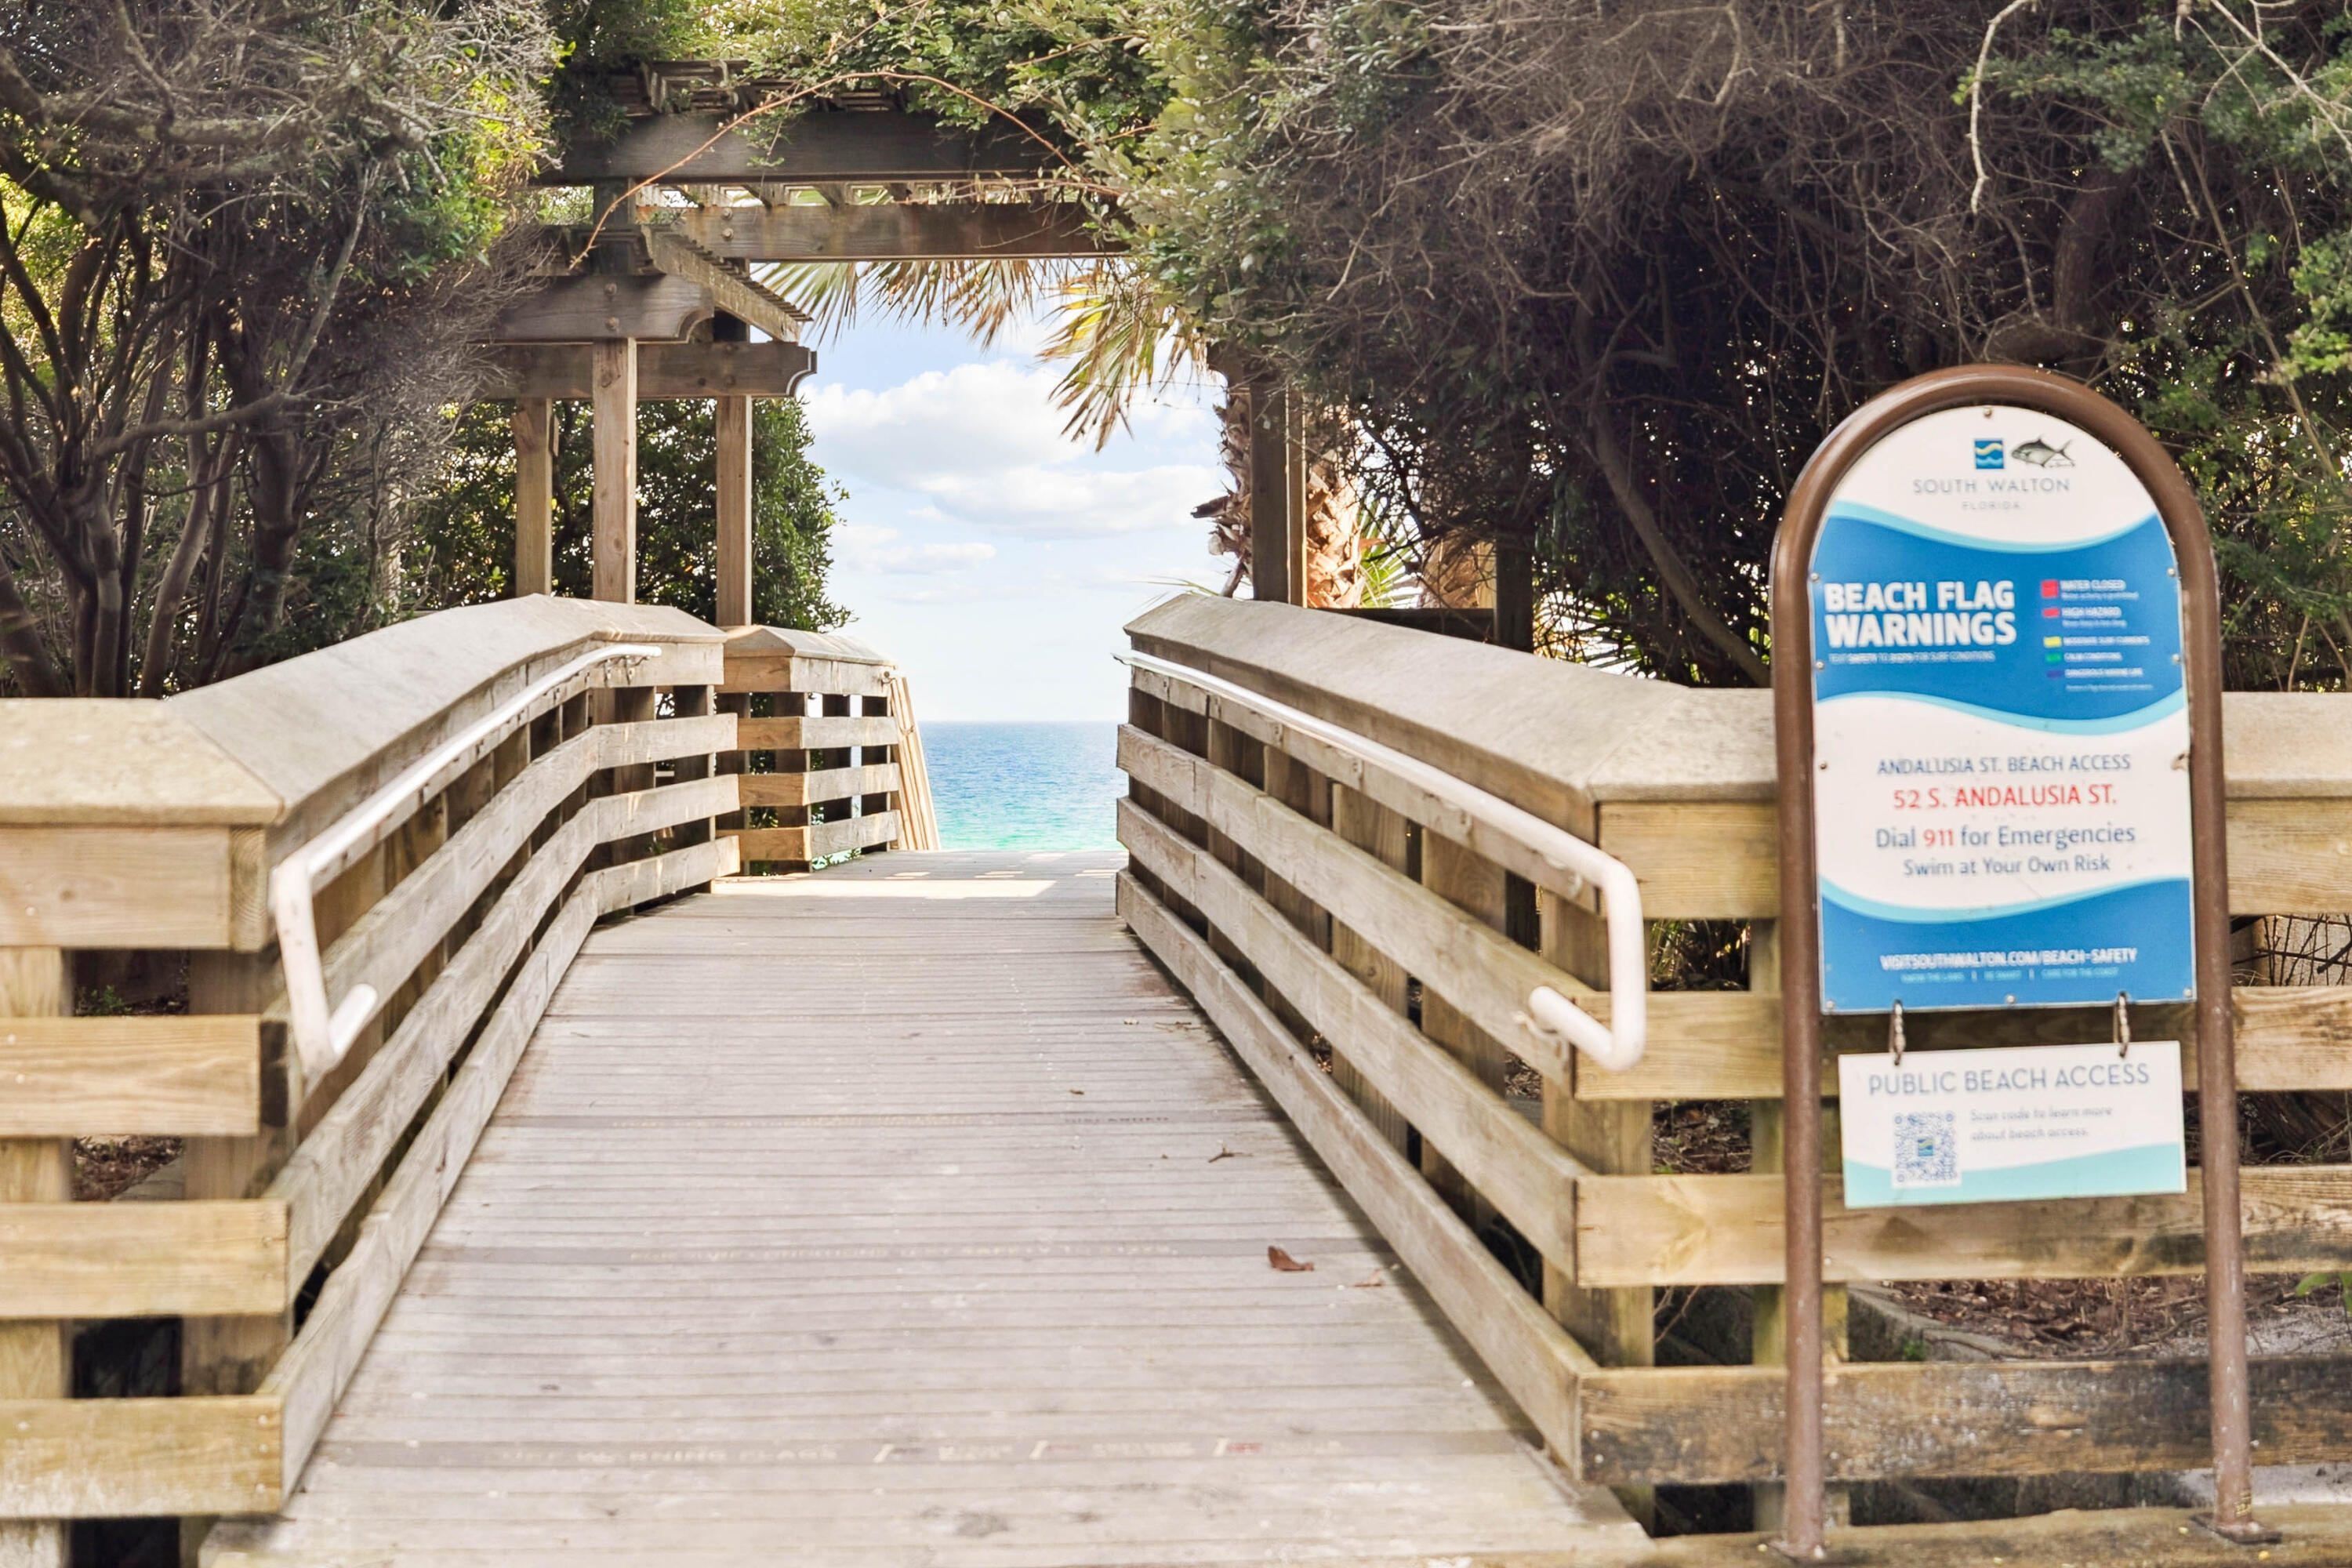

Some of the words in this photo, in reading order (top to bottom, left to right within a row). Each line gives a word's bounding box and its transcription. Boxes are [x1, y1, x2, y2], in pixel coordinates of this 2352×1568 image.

[1913, 478, 1976, 493] SOUTH
[1987, 477, 2070, 492] WALTON
[1824, 582, 1927, 612] BEACH
[1937, 580, 2016, 611] FLAG
[1824, 612, 2017, 648] WARNINGS
[1878, 758, 1974, 775] ANDALUSIA
[1979, 757, 2001, 773] ST.
[2008, 756, 2063, 772] BEACH
[2068, 754, 2131, 771] ACCESS
[1893, 789, 1920, 809] 52
[1929, 788, 1947, 808] S.
[1955, 785, 2081, 807] ANDALUSIA
[2088, 784, 2118, 804] ST.
[1876, 827, 1915, 848] Dial
[1923, 828, 1955, 848] 911
[1961, 824, 1990, 847] for
[1998, 822, 2136, 850] Emergencies
[1904, 858, 1954, 876] Swim
[1960, 860, 1976, 875] at
[1982, 857, 2021, 874] Your
[2027, 856, 2069, 873] Own
[2074, 854, 2111, 871] Risk
[1869, 1071, 1957, 1096] PUBLIC
[1964, 1069, 2047, 1091] BEACH
[2055, 1063, 2150, 1088] ACCESS
